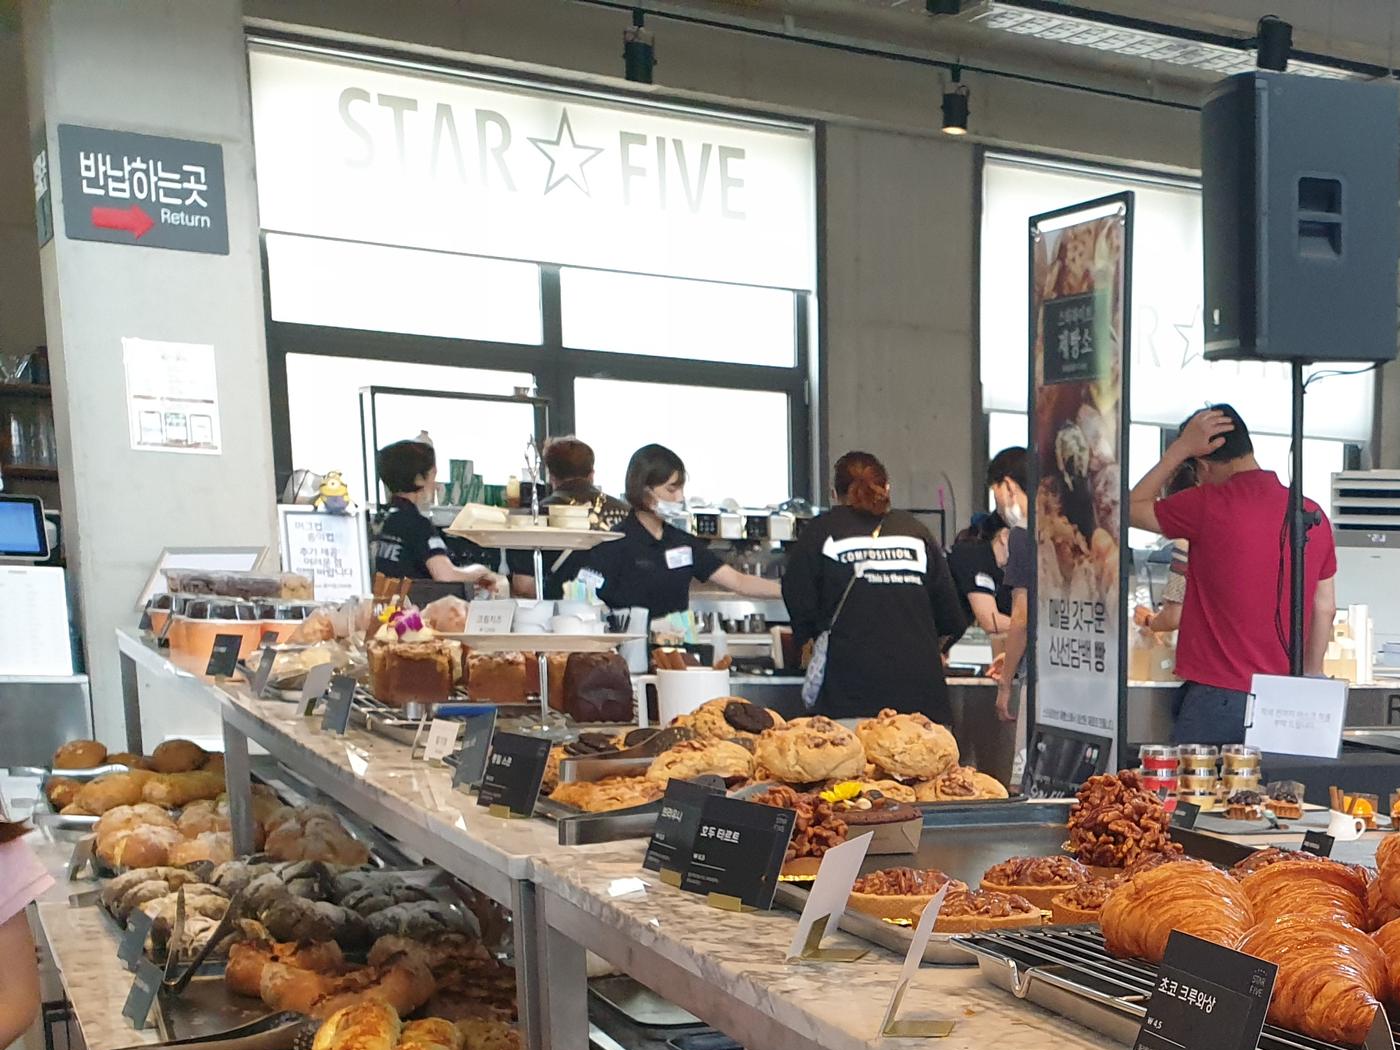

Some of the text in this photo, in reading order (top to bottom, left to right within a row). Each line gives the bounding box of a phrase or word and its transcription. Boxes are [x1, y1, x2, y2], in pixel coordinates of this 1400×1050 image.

[338, 86, 747, 220] STAR FIVE
[79, 151, 208, 208] 반납하는곳
[160, 208, 212, 229] Return
[1072, 600, 1106, 634] 갓구운
[700, 825, 741, 844] 호두 타르트
[1157, 976, 1217, 1014] 초코 크루와상
